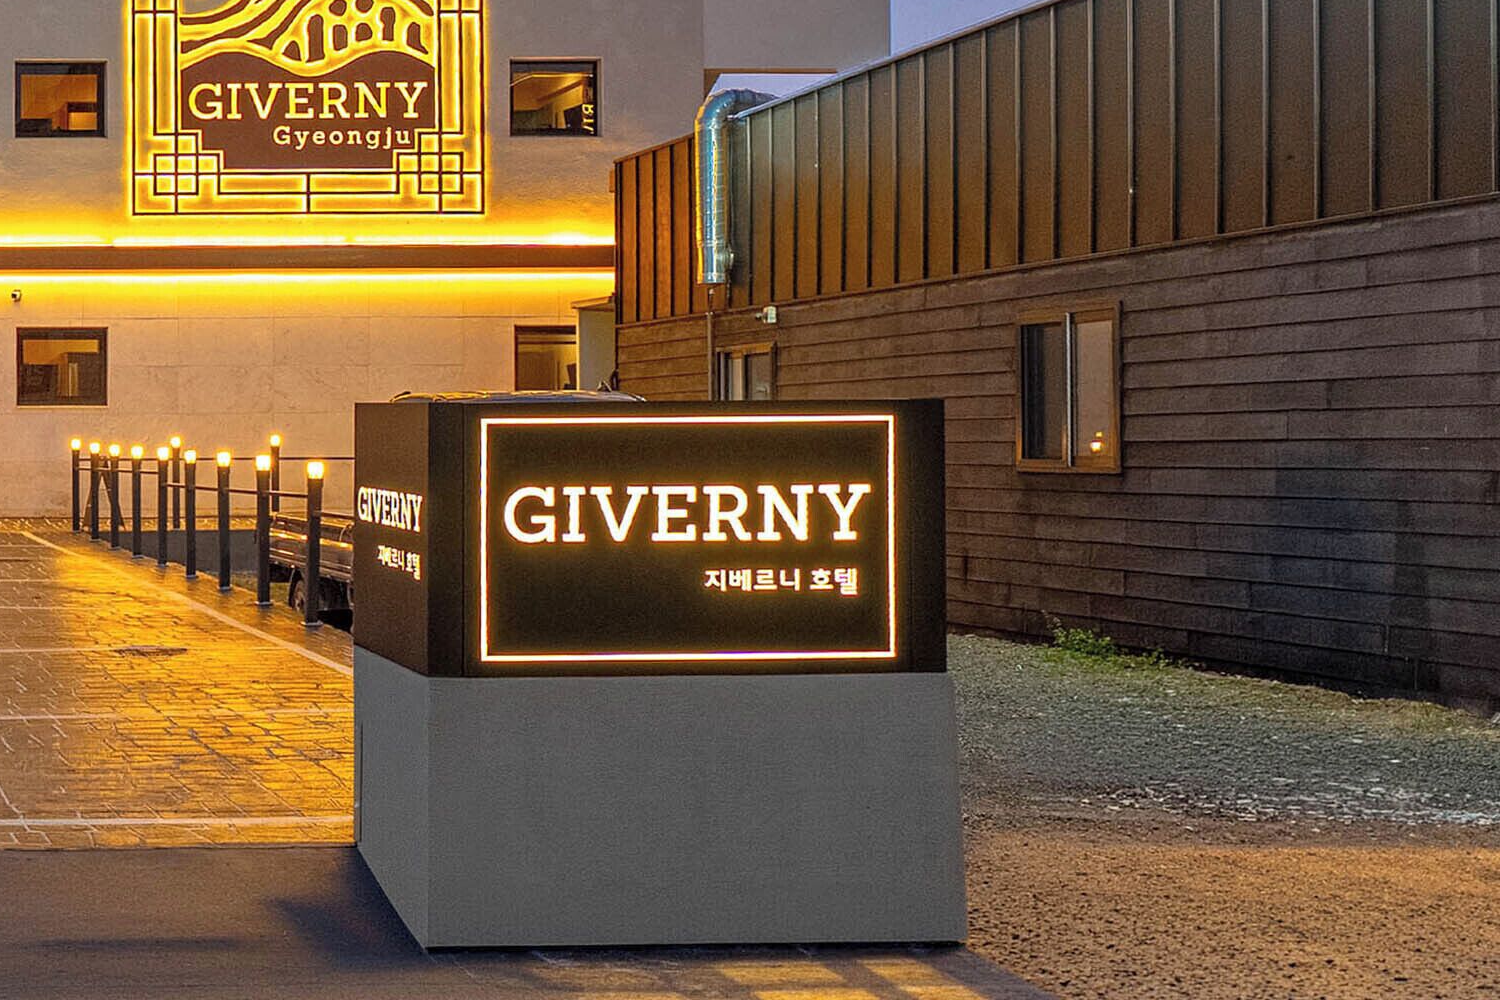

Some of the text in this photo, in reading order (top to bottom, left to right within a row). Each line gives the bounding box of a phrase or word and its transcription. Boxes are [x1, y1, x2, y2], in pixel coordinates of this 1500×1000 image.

[188, 82, 428, 120] GIVERNY
[272, 126, 412, 150] Gyeongju
[358, 486, 422, 532] GIVERNY
[503, 484, 871, 543] GIVERNY
[704, 568, 858, 595] 지베르니 호텔
